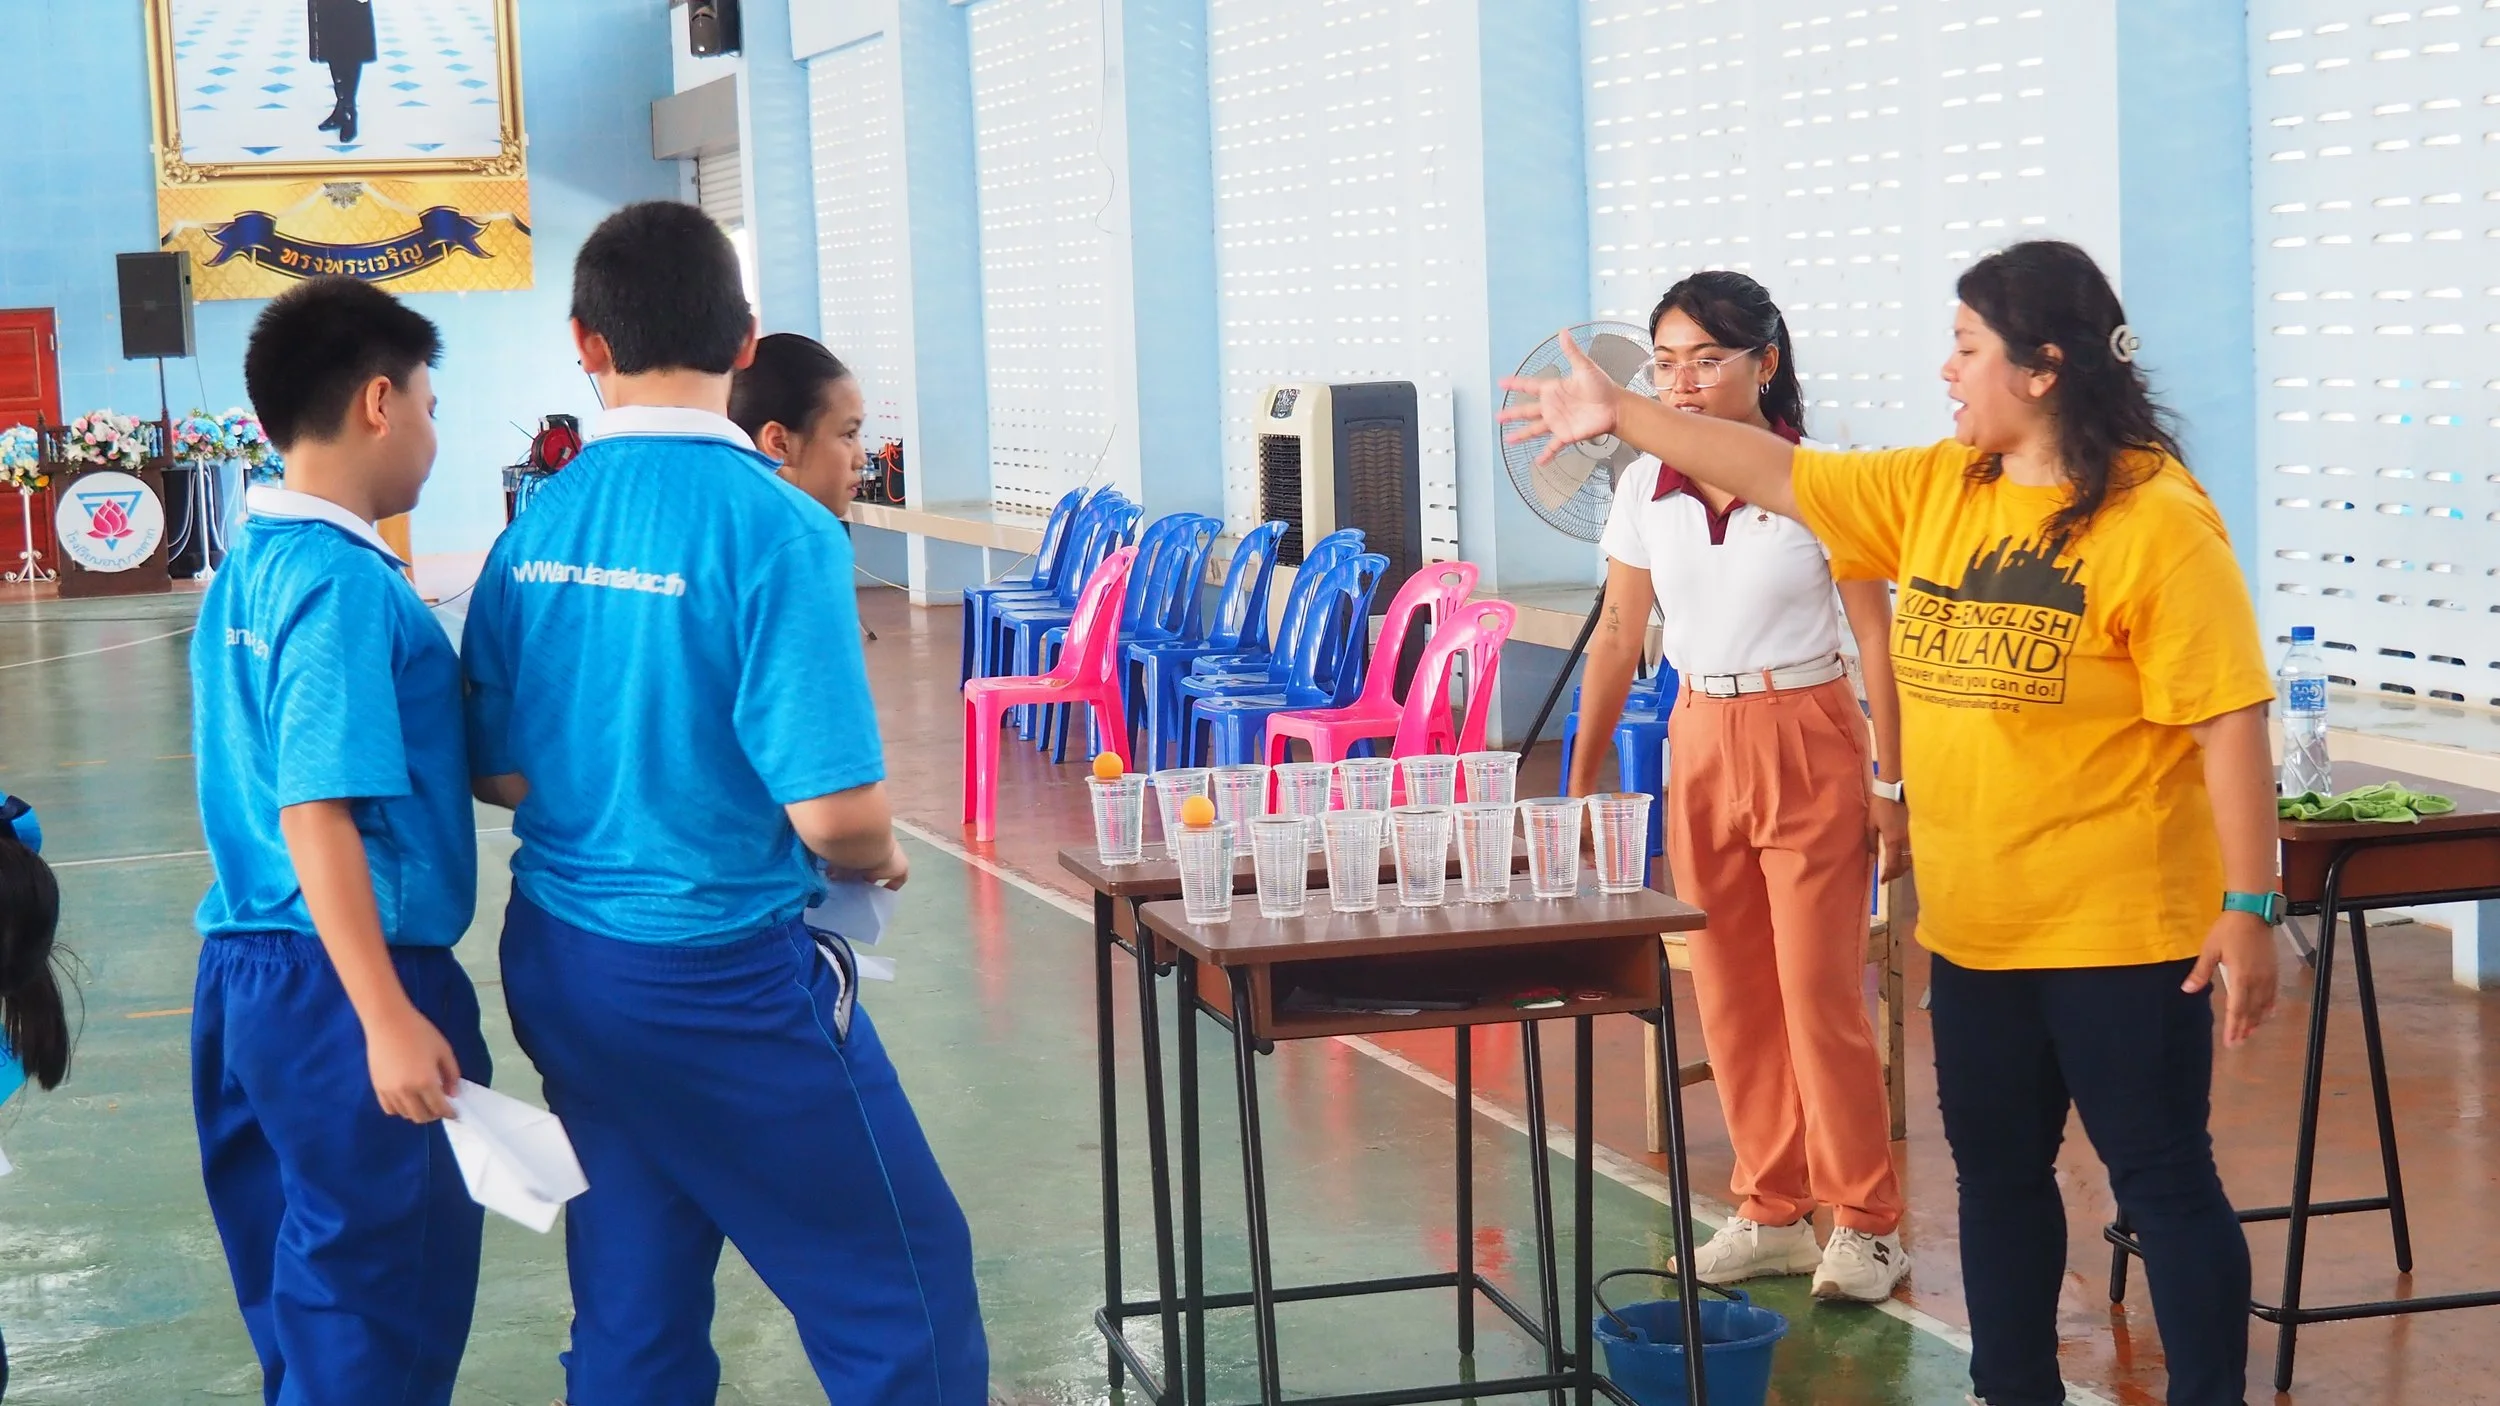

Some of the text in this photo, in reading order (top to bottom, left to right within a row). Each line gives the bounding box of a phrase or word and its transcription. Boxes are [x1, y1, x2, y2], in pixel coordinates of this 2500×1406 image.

[279, 243, 424, 275] ทรงพระเจริญ
[1894, 618, 2061, 674] THAILAND
[1893, 661, 2057, 697] scover what you can do!
